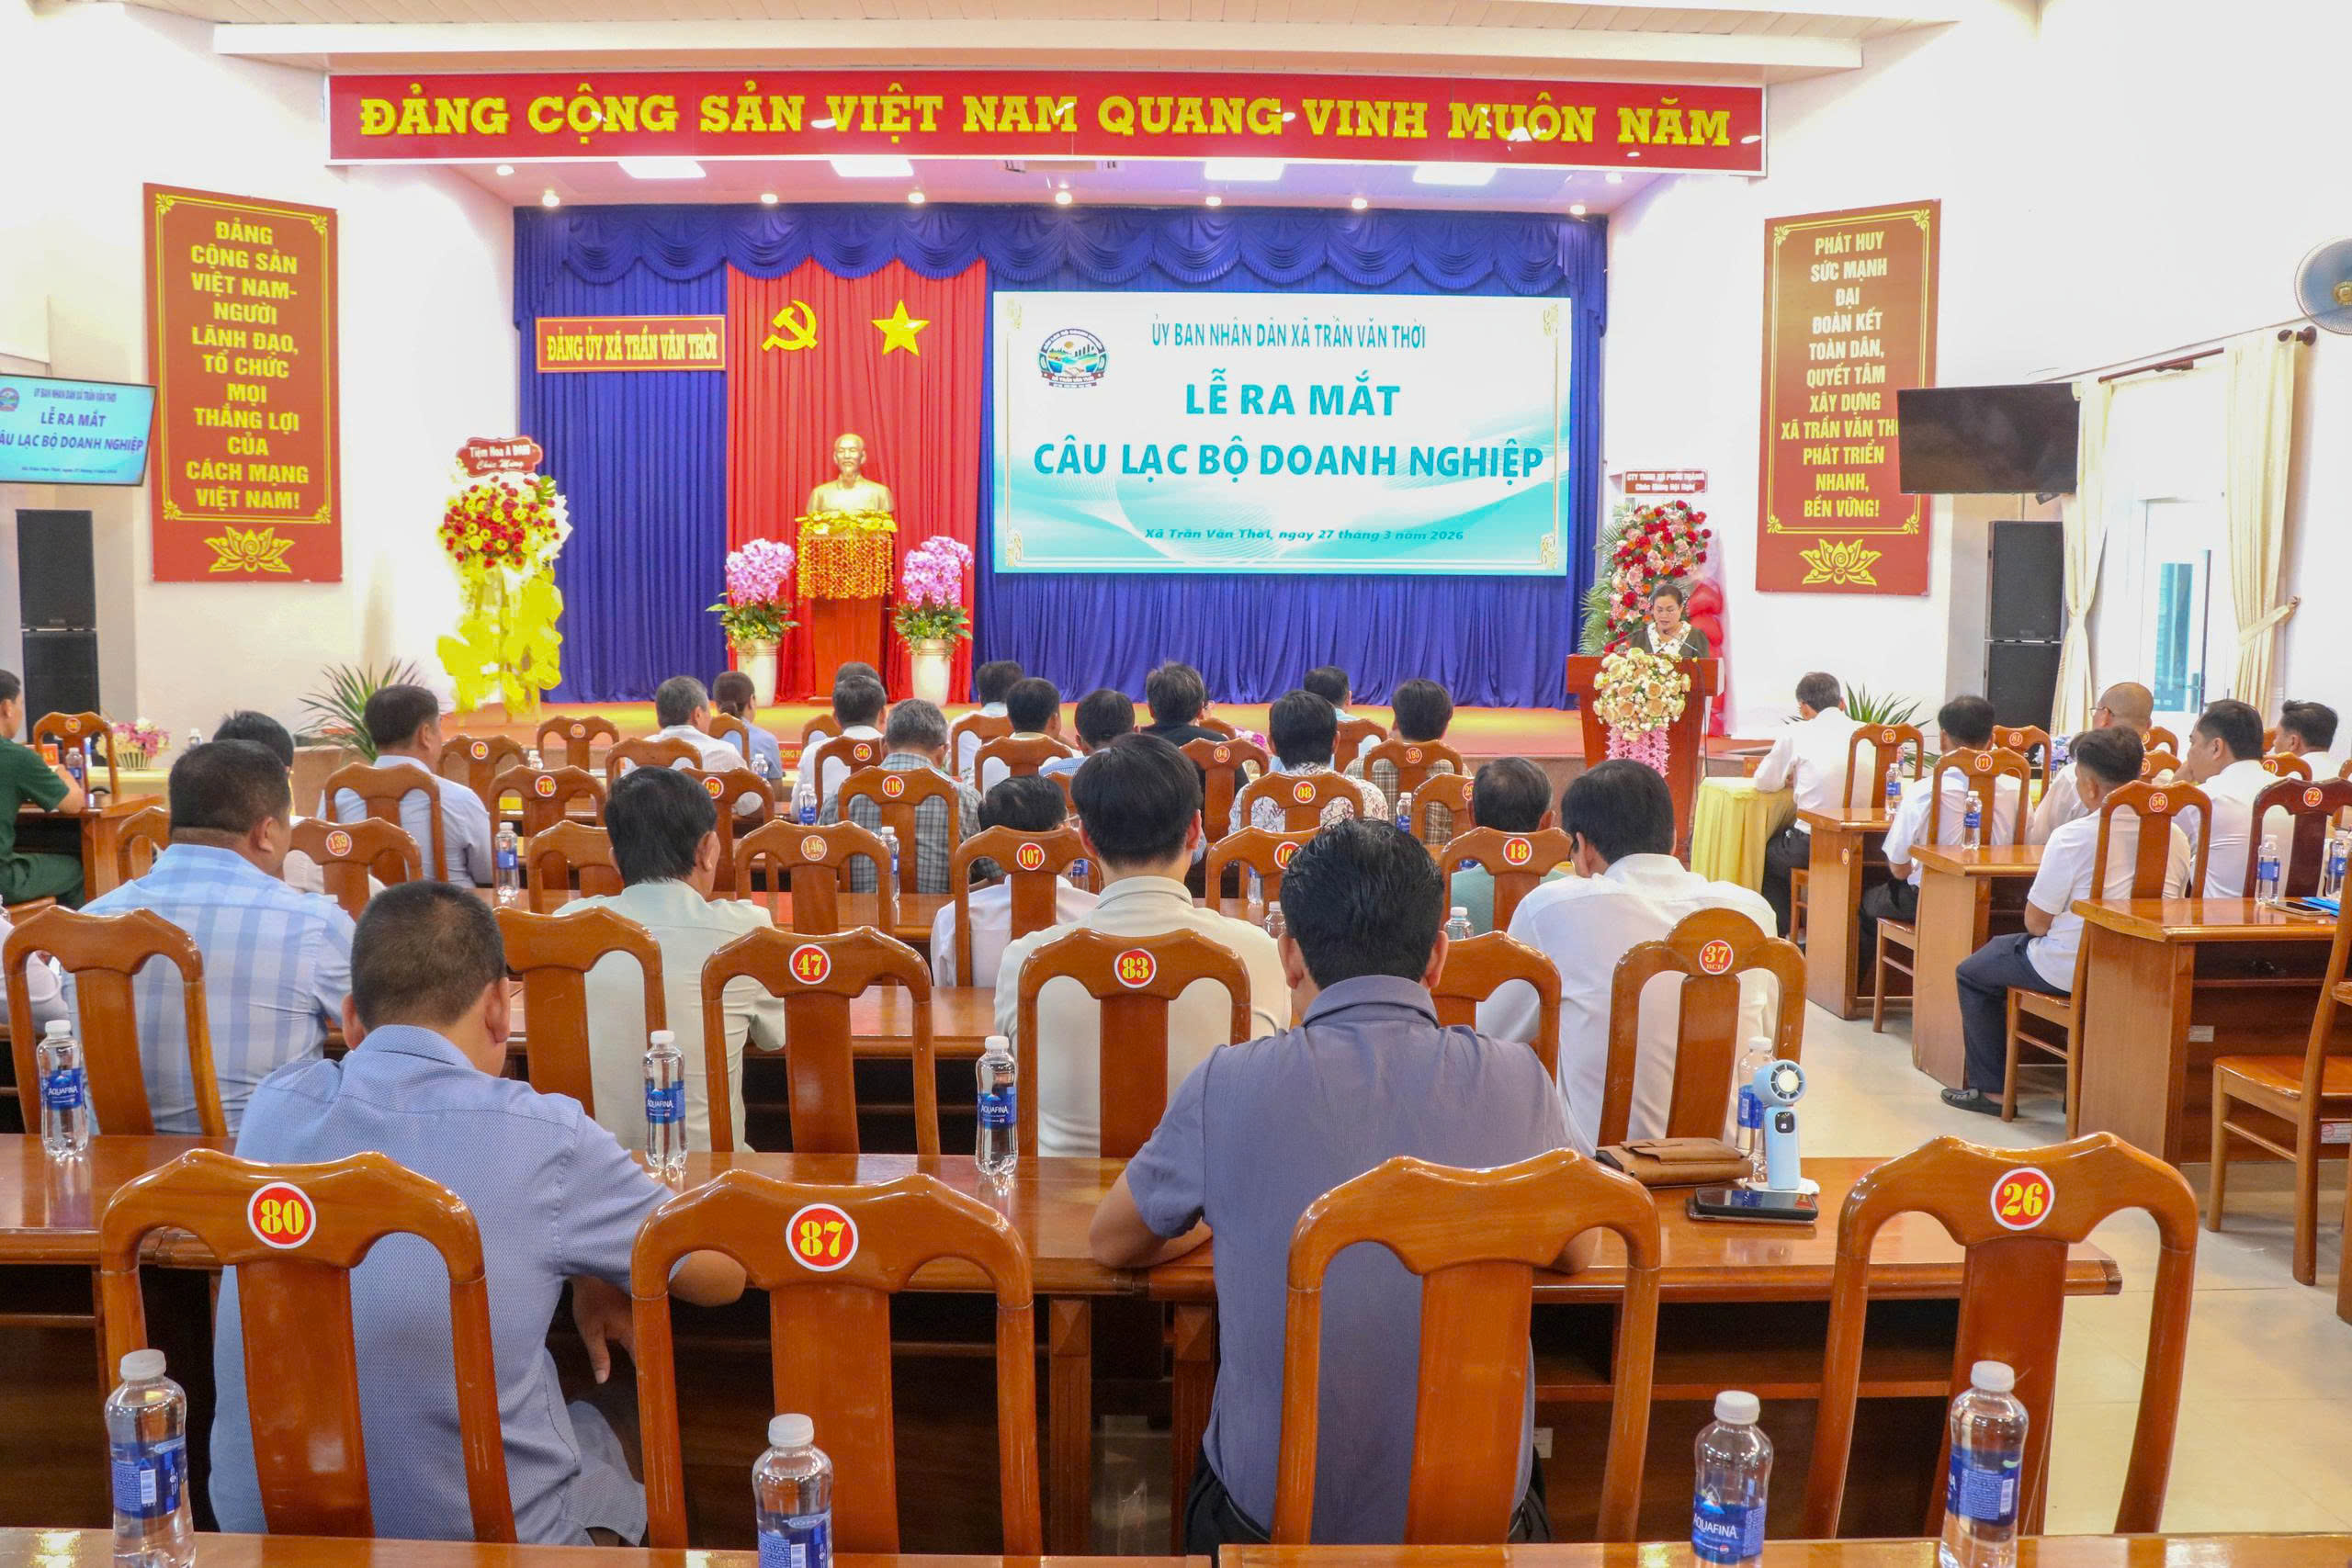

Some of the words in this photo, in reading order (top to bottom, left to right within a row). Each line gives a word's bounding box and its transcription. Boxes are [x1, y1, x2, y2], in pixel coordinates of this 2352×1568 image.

[359, 83, 510, 135] ĐẢNG
[527, 83, 679, 144] CỘNG
[699, 80, 805, 133] SẢN
[826, 83, 944, 143] VIỆT
[962, 96, 1078, 132] NAM
[1098, 96, 1283, 136] QUANG
[1302, 99, 1428, 139] VINH
[1447, 92, 1596, 142] MUÔN
[1617, 97, 1730, 146] NĂM
[215, 217, 274, 245] ĐẢNG
[1815, 231, 1852, 256] PHÁT
[1855, 231, 1885, 252] HUY
[190, 243, 249, 270] CỘNG
[255, 249, 298, 275] SẢN
[1810, 259, 1840, 284] SỨC
[1843, 257, 1888, 283] MẠNH
[191, 271, 236, 298] VIỆT
[1835, 287, 1860, 310] ĐẠI
[212, 301, 277, 327] NGƯỜI
[1811, 311, 1853, 335] ĐOÀN
[1855, 307, 1883, 332] KẾT
[191, 324, 246, 352] LÃNH
[253, 334, 299, 356] ĐẠO,
[547, 325, 583, 362] ĐẢNG
[584, 324, 604, 361] ỦY
[624, 323, 659, 361] TRẦN
[660, 327, 686, 360] VĂN
[687, 325, 718, 360] THỜI
[1151, 313, 1170, 346] ỦY
[1174, 322, 1205, 347] BAN
[1209, 316, 1252, 347] NHÂN
[1256, 316, 1287, 347] DÂN
[1291, 316, 1310, 347] XÃ
[1314, 315, 1353, 348] TRẦN
[1356, 317, 1387, 349] VĂN
[1391, 317, 1426, 349] THỜI
[1808, 338, 1847, 361] TOÀN
[1850, 337, 1885, 359] DÂN,
[201, 351, 229, 375] TỔ
[234, 355, 289, 379] CHỨC
[1806, 364, 1851, 389] QUYẾT
[1854, 364, 1886, 385] TÂM
[225, 383, 267, 409] MỌI
[1185, 368, 1227, 416] LỄ
[1240, 383, 1295, 416] RA
[1309, 369, 1401, 417] MẮT
[1809, 390, 1838, 413] XÂY
[1841, 390, 1881, 416] DỰNG
[40, 406, 55, 424] LỄ
[57, 412, 74, 426] RA
[78, 409, 107, 428] MẮT
[193, 406, 263, 431] THẮNG
[268, 411, 300, 435] LỢI
[1781, 418, 1800, 440] XÃ
[1804, 416, 1840, 440] TRẦN
[1844, 416, 1874, 437] VĂN
[1877, 418, 1898, 437] TH
[0, 429, 14, 446] ÂU
[17, 434, 40, 450] LẠC
[41, 433, 58, 451] BỘ
[61, 436, 101, 450] DOANH
[104, 435, 144, 455] NGHIỆP
[227, 434, 269, 457] CỦA
[1803, 443, 1839, 467] PHÁT
[1842, 438, 1885, 465] TRIỂN
[186, 458, 243, 482] CÁCH
[248, 463, 310, 487] MẠNG
[1034, 434, 1106, 476] CÂU
[1122, 443, 1189, 484] LẠC
[1198, 435, 1250, 484] BỘ
[1260, 444, 1397, 477] DOANH
[1410, 437, 1544, 487] NGHIỆP
[1815, 472, 1870, 493] NHANH,
[195, 485, 240, 512] VIỆT
[244, 490, 300, 510] NAM!
[1804, 494, 1832, 518] BỀN
[1836, 496, 1880, 518] VỮNG!
[1317, 529, 1335, 539] 27
[1383, 530, 1392, 540] 3
[1430, 530, 1464, 541] 2026
[1296, 786, 1312, 799] 08
[805, 837, 824, 853] 146
[1021, 849, 1040, 864] 107
[1510, 843, 1529, 860] 18
[797, 954, 823, 976] 47
[1122, 956, 1149, 979] 83
[1704, 945, 1728, 964] 37
[48, 1085, 79, 1096] AQUAFINA
[980, 1104, 1009, 1114] AQUAFINA
[2000, 1182, 2044, 1217] 26
[260, 1199, 305, 1235] 80
[799, 1220, 846, 1258] 87
